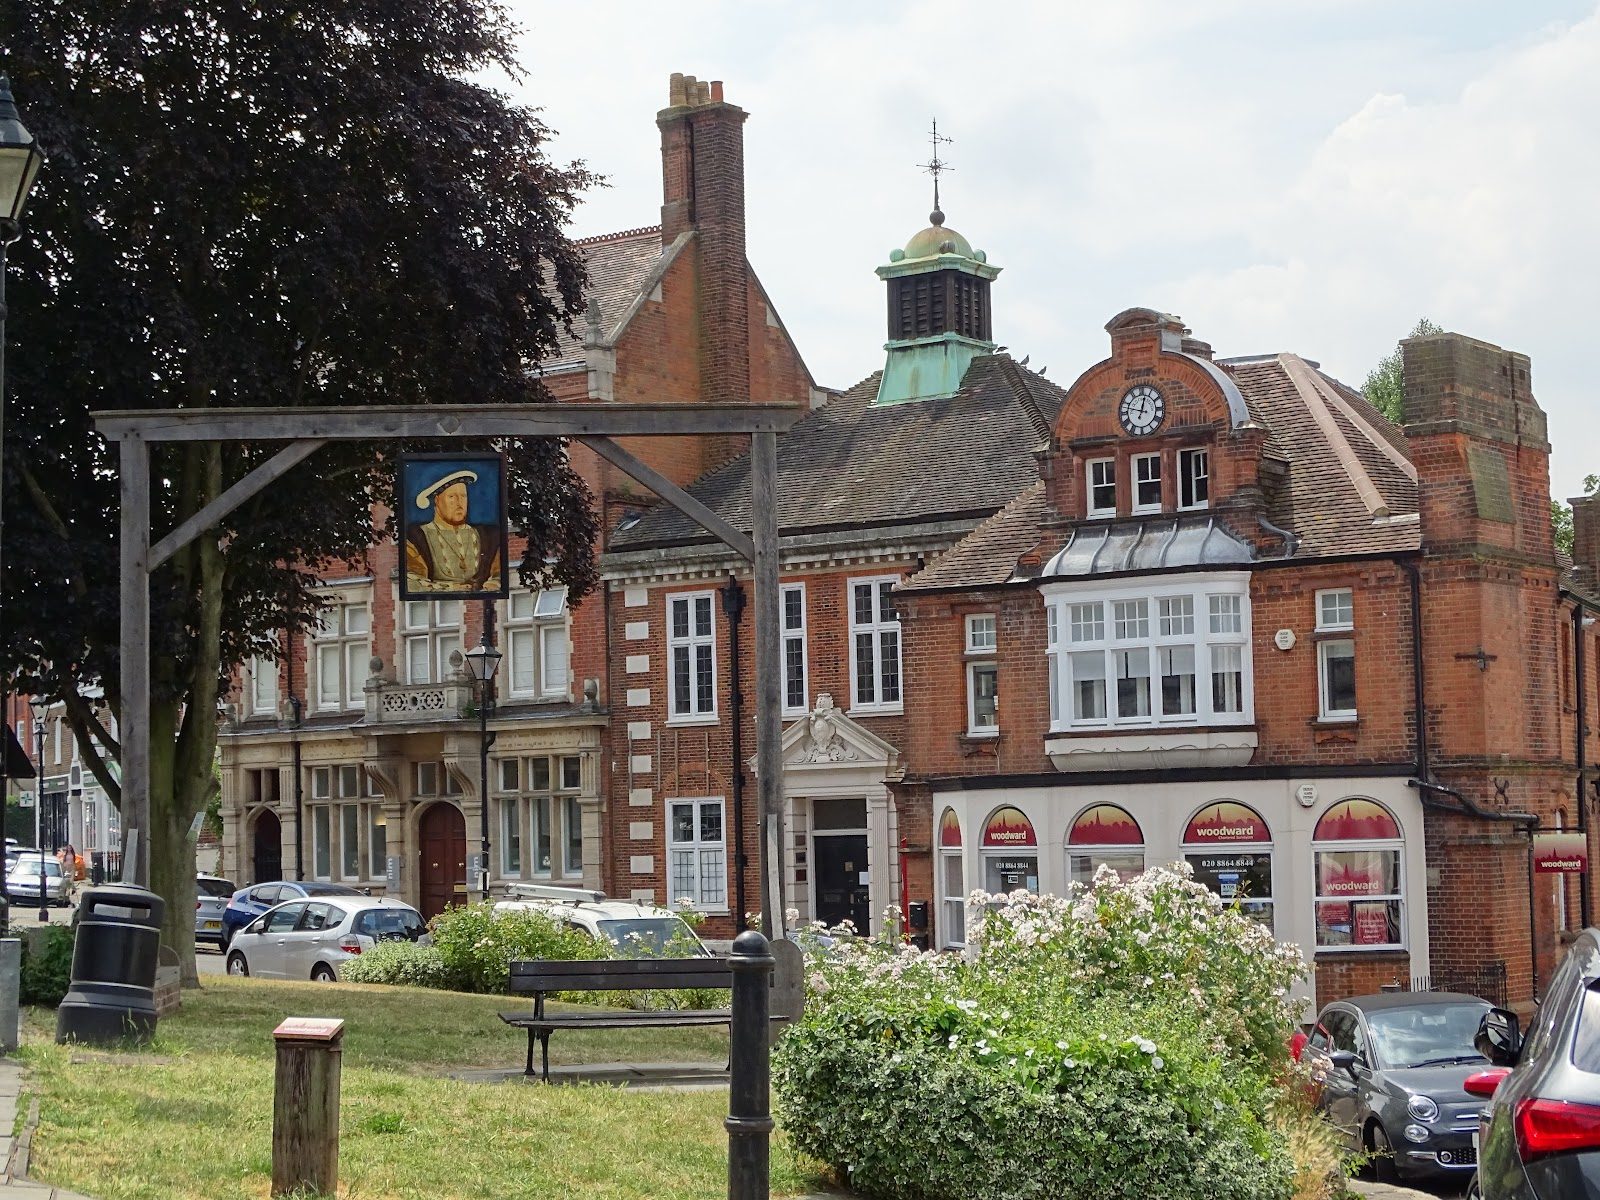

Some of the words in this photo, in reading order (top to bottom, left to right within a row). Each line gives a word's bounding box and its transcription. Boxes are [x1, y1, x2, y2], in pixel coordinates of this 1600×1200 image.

[991, 831, 1026, 839] woodward
[1197, 826, 1253, 836] woodward
[1236, 859, 1254, 867] 8844
[1327, 881, 1379, 891] woodward
